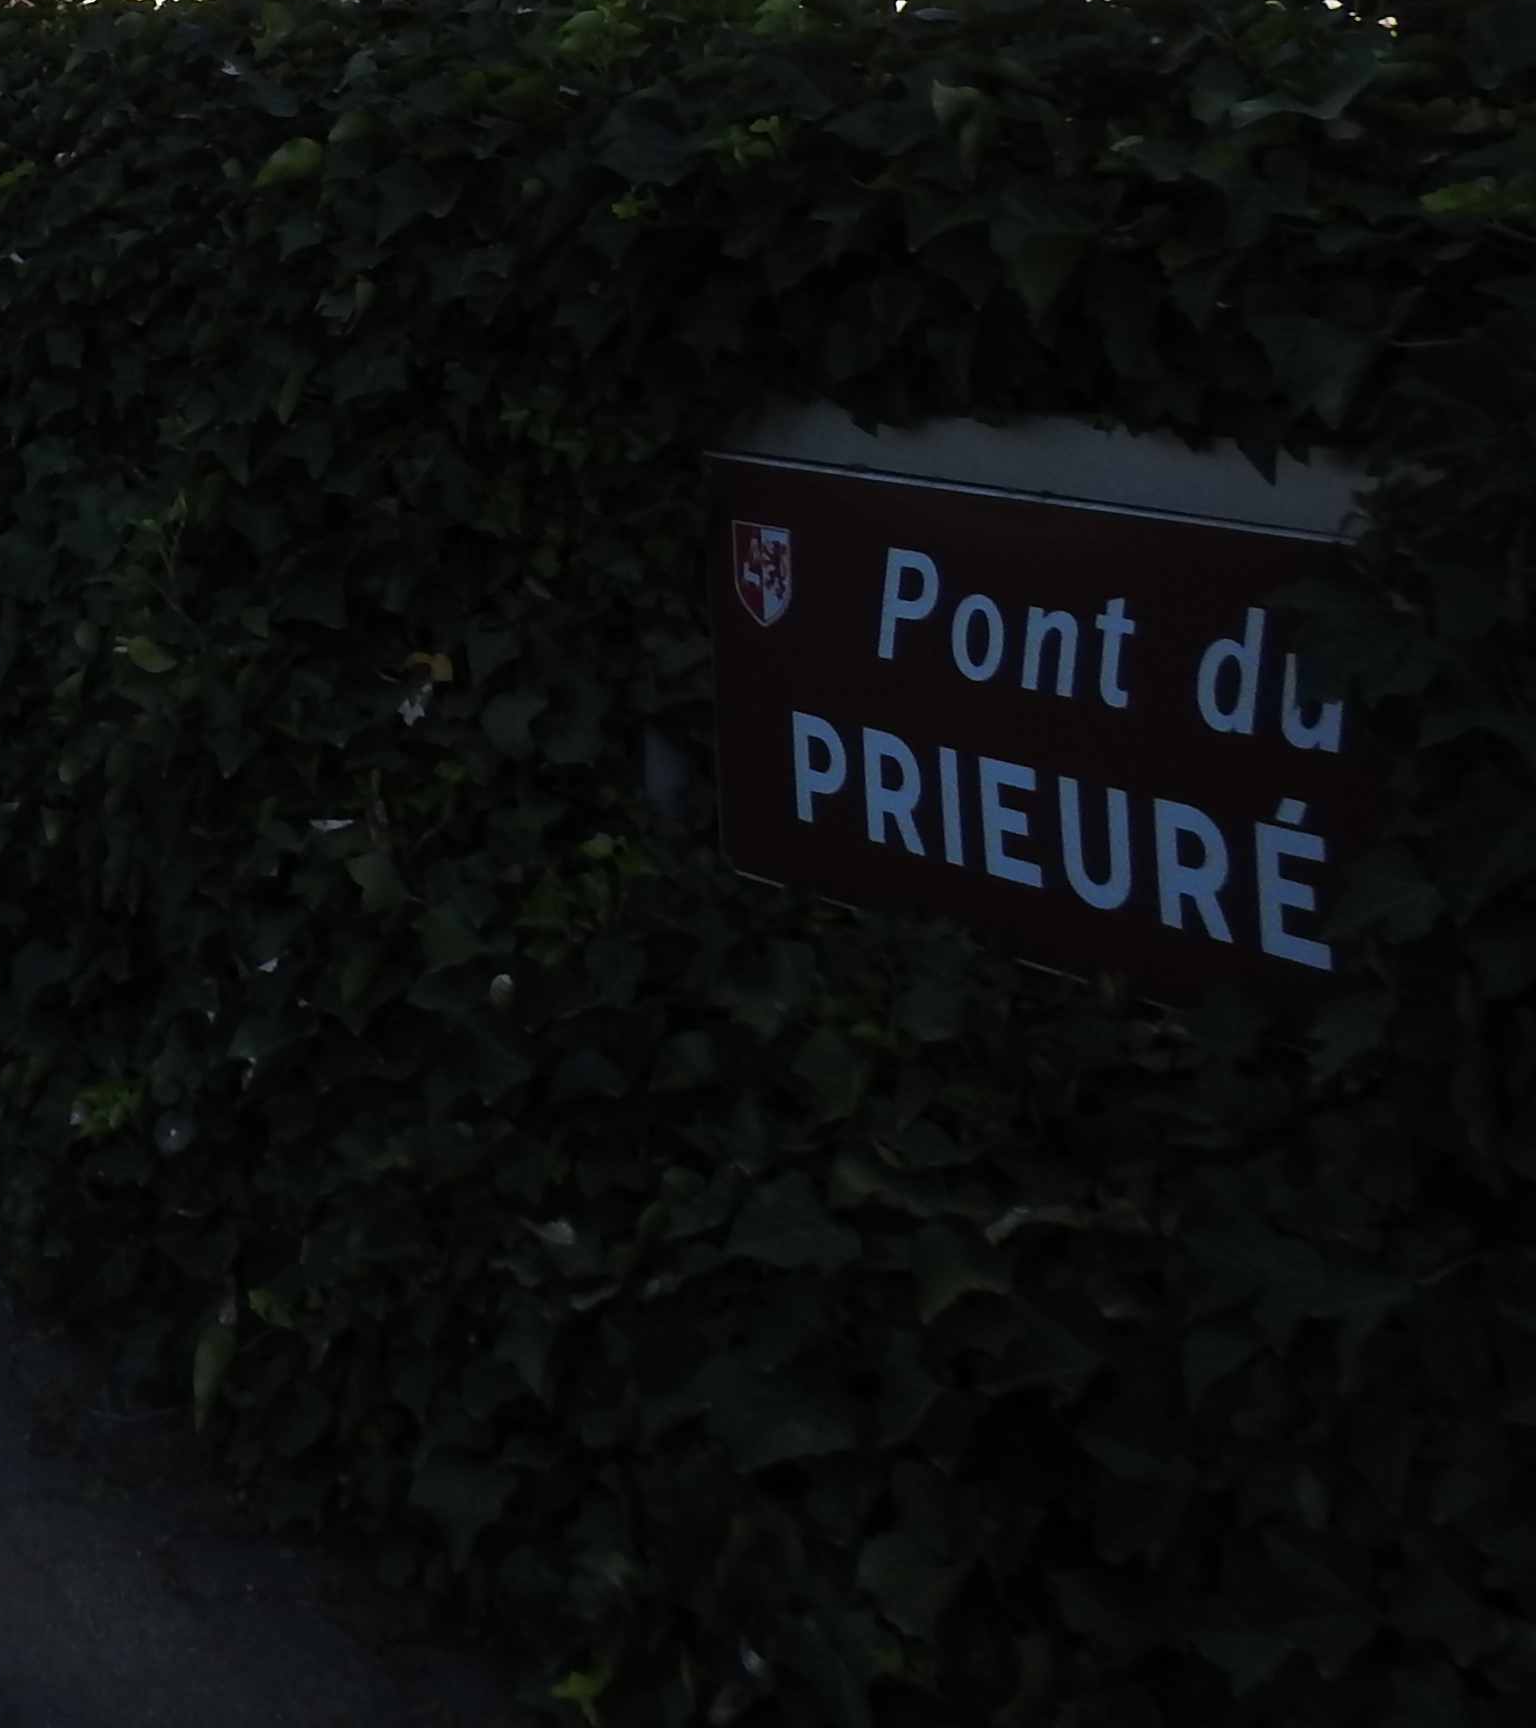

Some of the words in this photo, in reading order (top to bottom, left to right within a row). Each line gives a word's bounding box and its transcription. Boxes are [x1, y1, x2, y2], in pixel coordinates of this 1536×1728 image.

[877, 547, 1136, 709] Pont
[1196, 606, 1343, 753] du
[791, 710, 1332, 971] PRIEURÉ
